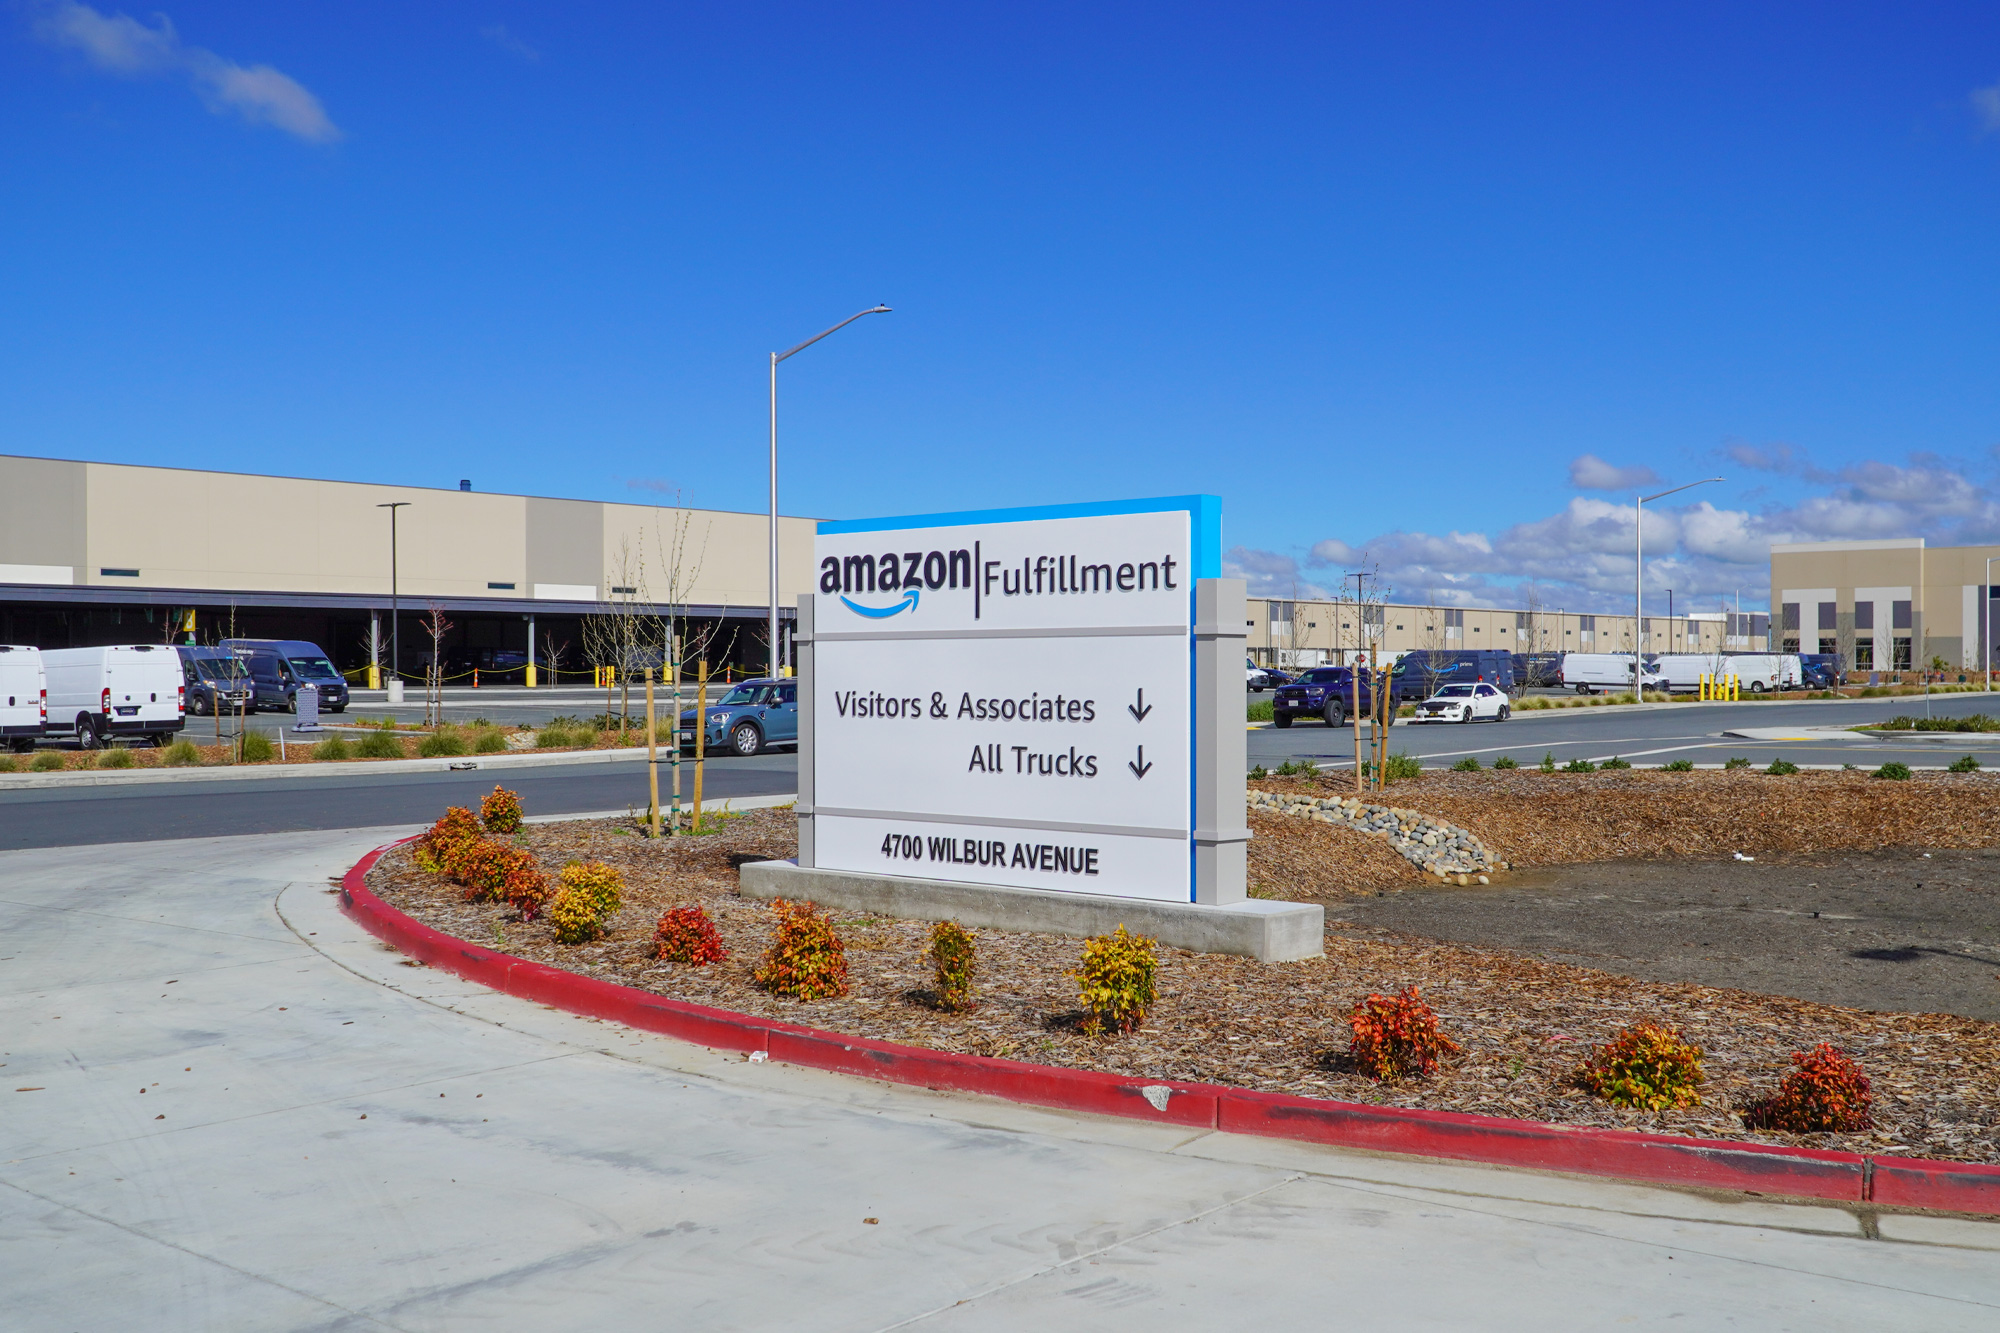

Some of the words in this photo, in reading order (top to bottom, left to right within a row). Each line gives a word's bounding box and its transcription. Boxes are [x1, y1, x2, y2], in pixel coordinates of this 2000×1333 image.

[819, 549, 971, 595] amazon
[984, 554, 1177, 597] Fulfillment
[835, 690, 921, 718] Visitors
[929, 691, 949, 718] &
[957, 691, 1096, 722] Associates
[968, 743, 1003, 773] All
[1011, 745, 1098, 777] Trucks
[881, 833, 923, 860] 4700
[927, 836, 1007, 867] WILBUR
[1010, 841, 1099, 875] AVENUE
